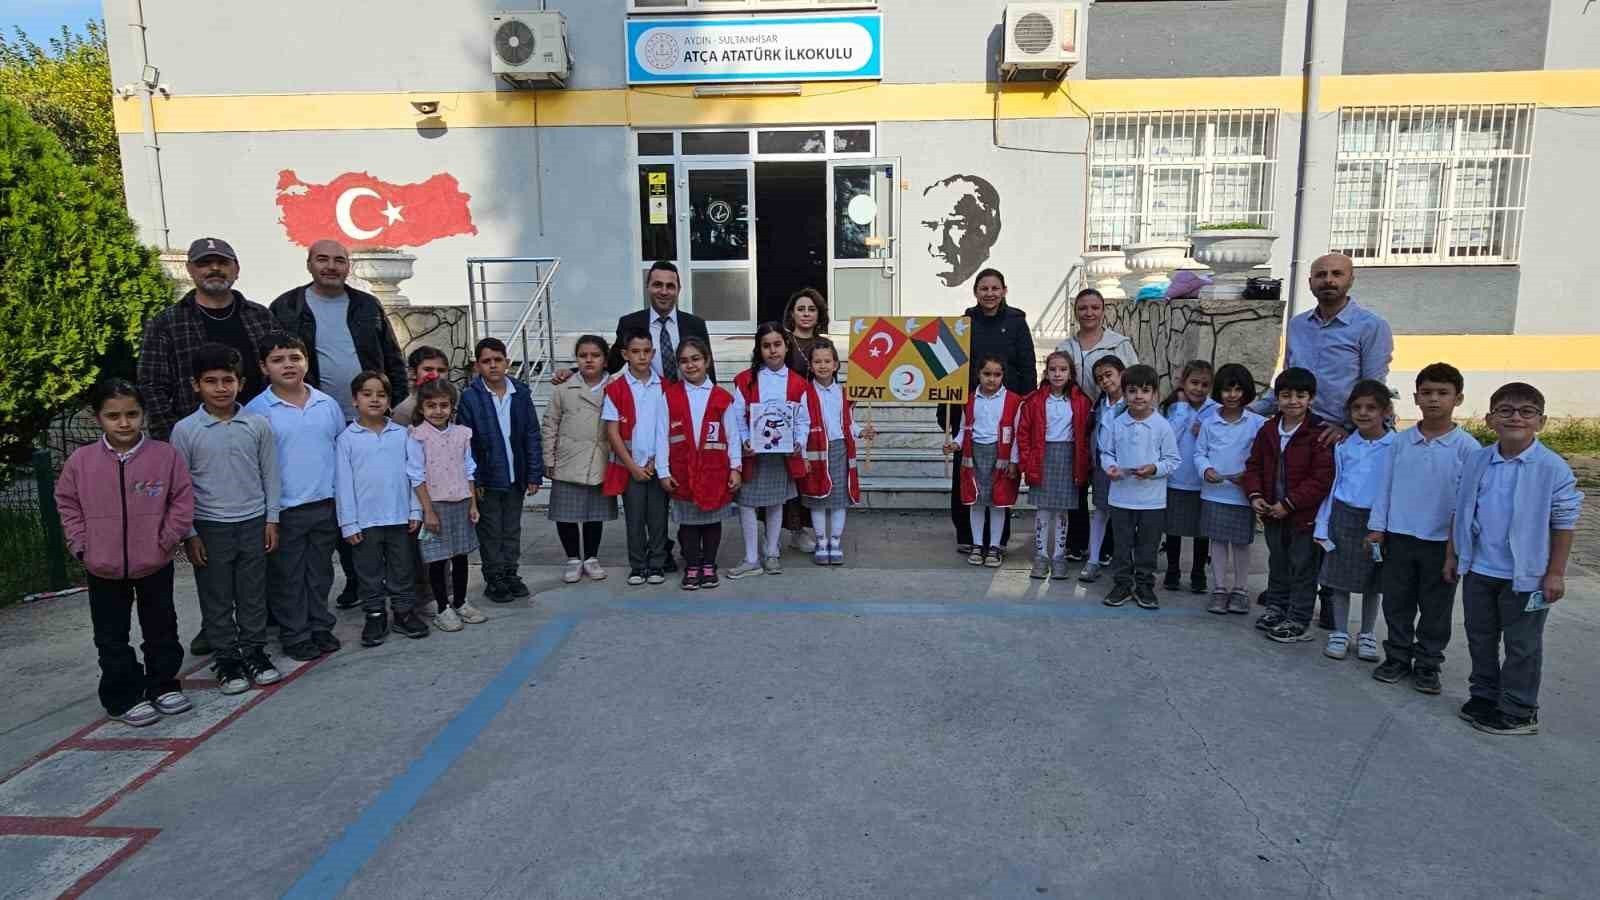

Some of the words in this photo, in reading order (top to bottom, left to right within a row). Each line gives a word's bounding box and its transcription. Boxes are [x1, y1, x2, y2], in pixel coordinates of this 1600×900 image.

[684, 35, 711, 45] AYDIN
[684, 50, 718, 65] ATÇA
[721, 46, 781, 62] ATATÜRK
[785, 46, 853, 61] İLKOKULU
[849, 386, 885, 398] UZAT
